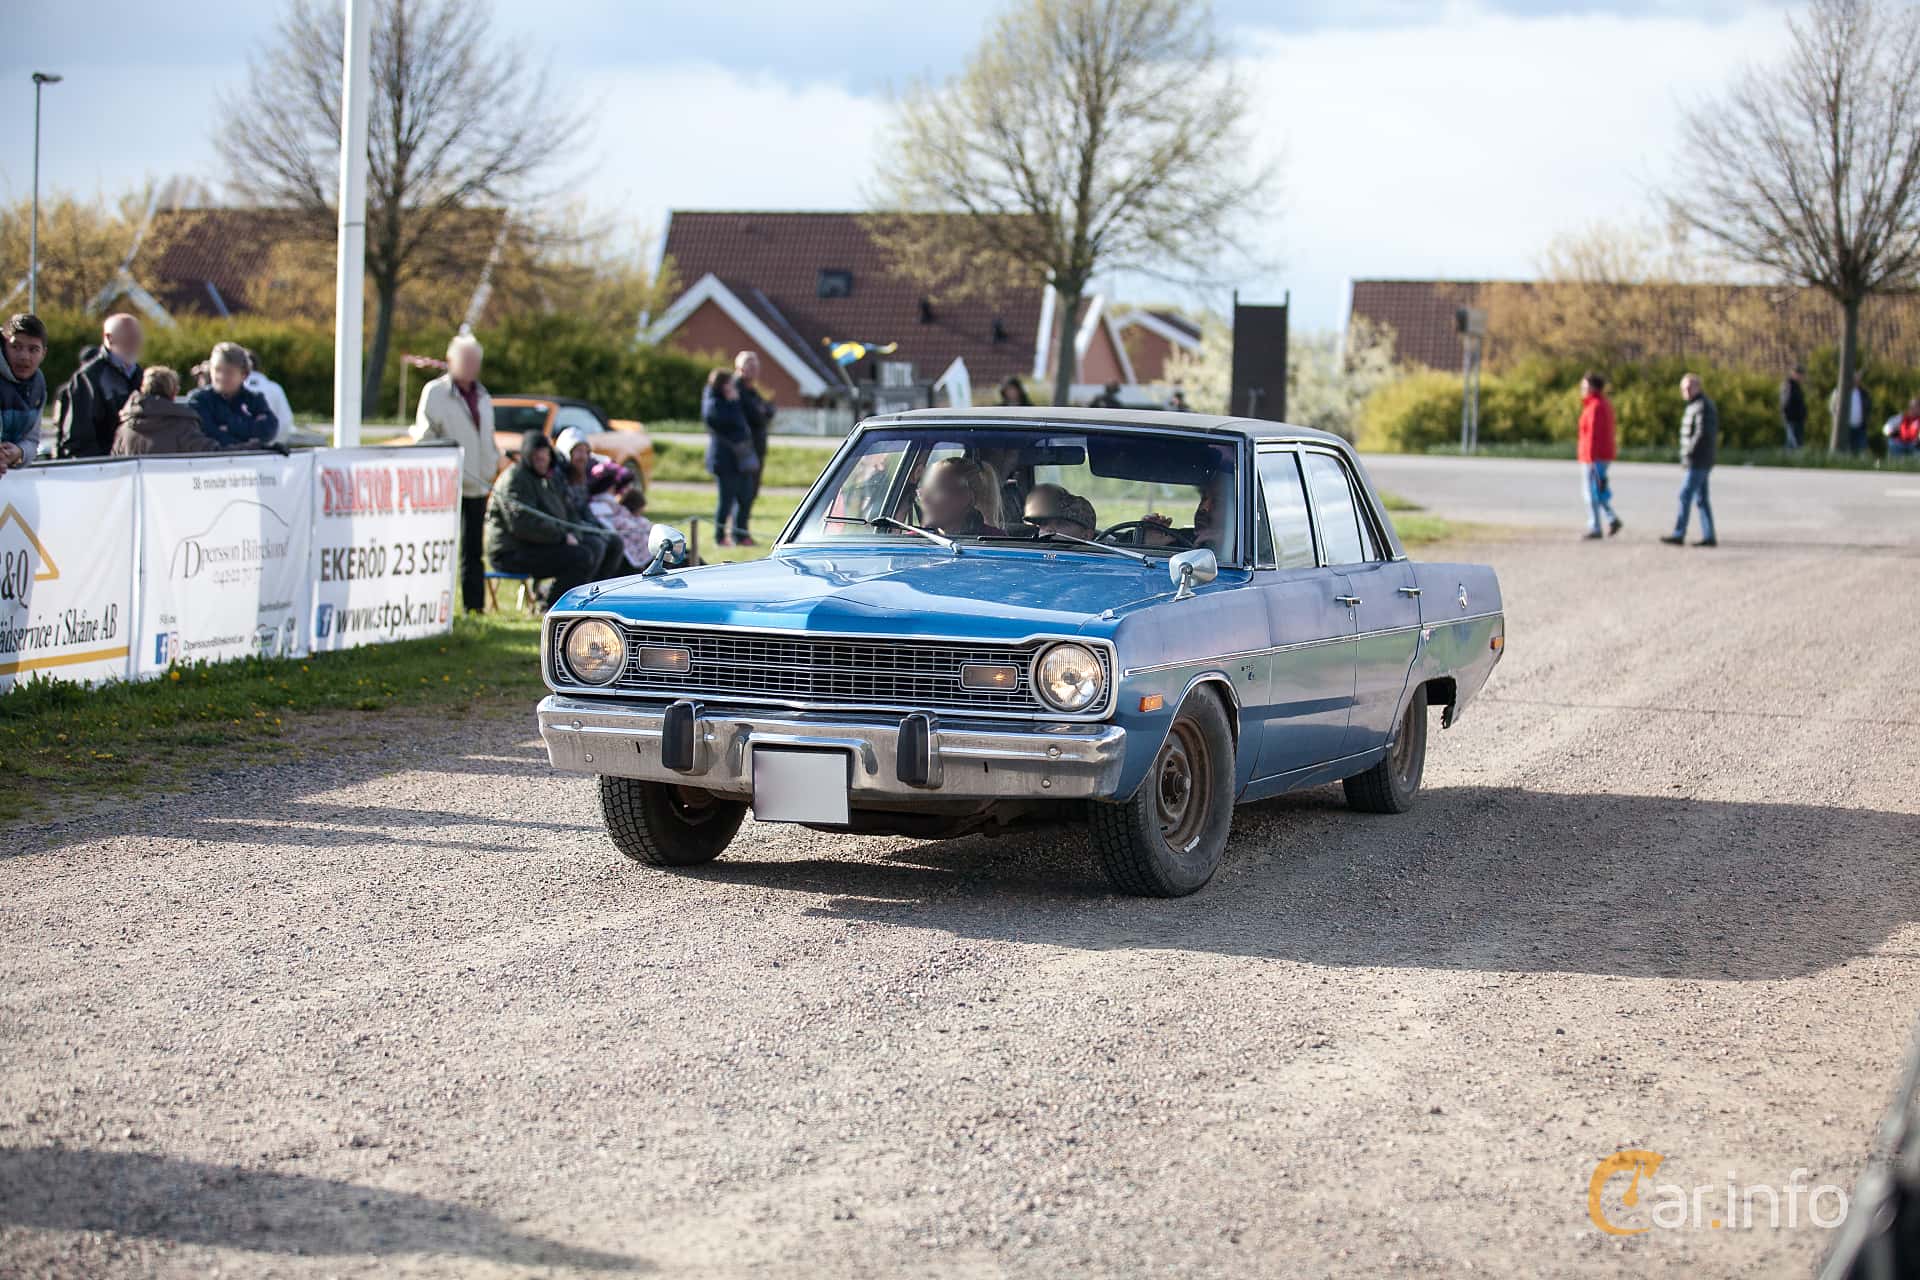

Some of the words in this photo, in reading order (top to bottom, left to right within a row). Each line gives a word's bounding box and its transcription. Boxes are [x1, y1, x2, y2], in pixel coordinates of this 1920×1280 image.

[321, 467, 392, 516] TRACTOR
[321, 536, 386, 581] EKERÖD
[392, 542, 415, 576] 23
[54, 612, 62, 647] i
[62, 608, 98, 646] Skåne
[100, 602, 118, 641] AB
[336, 593, 437, 636] www.stpk.nu
